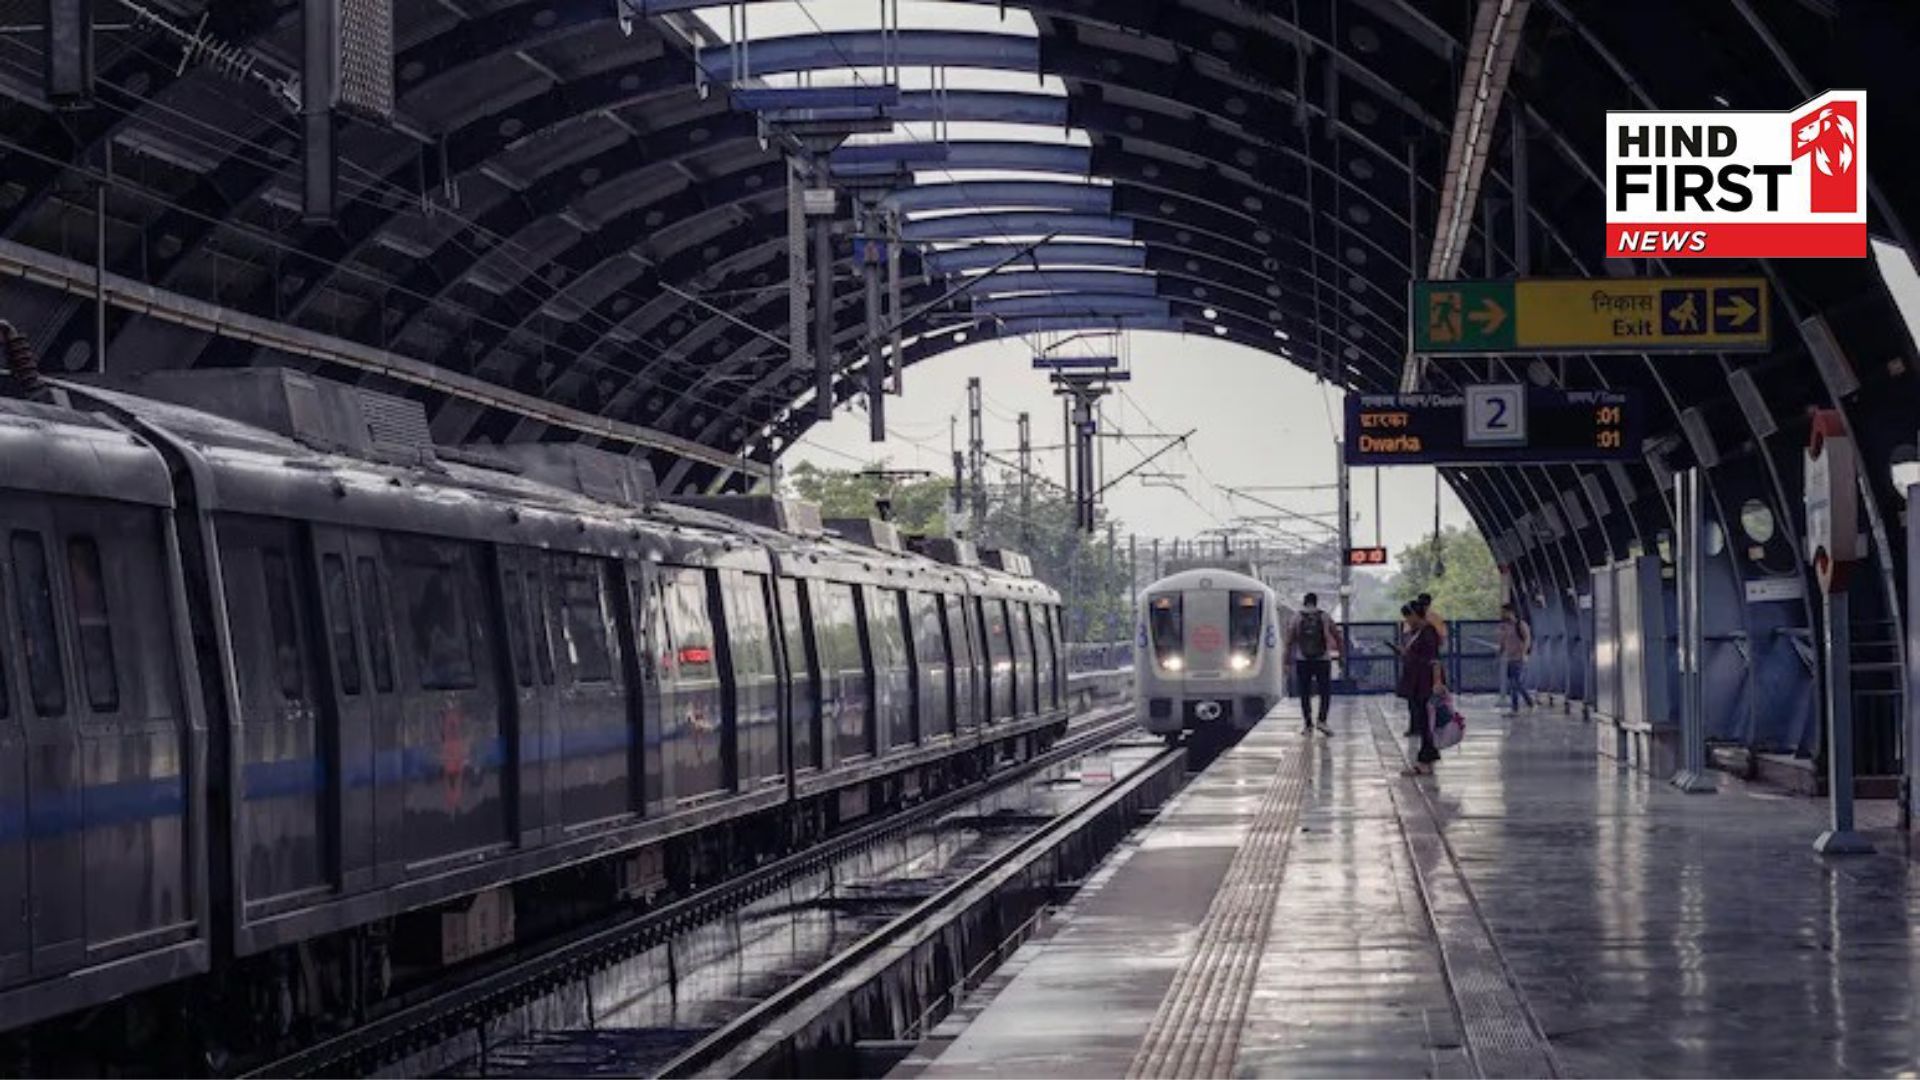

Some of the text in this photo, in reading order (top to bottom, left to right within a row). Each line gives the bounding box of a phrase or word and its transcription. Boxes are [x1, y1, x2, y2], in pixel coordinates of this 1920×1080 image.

[1592, 290, 1654, 312] निकास
[1613, 319, 1653, 335] Exit
[1487, 397, 1508, 429] 2
[1359, 435, 1421, 452] Dwarka
